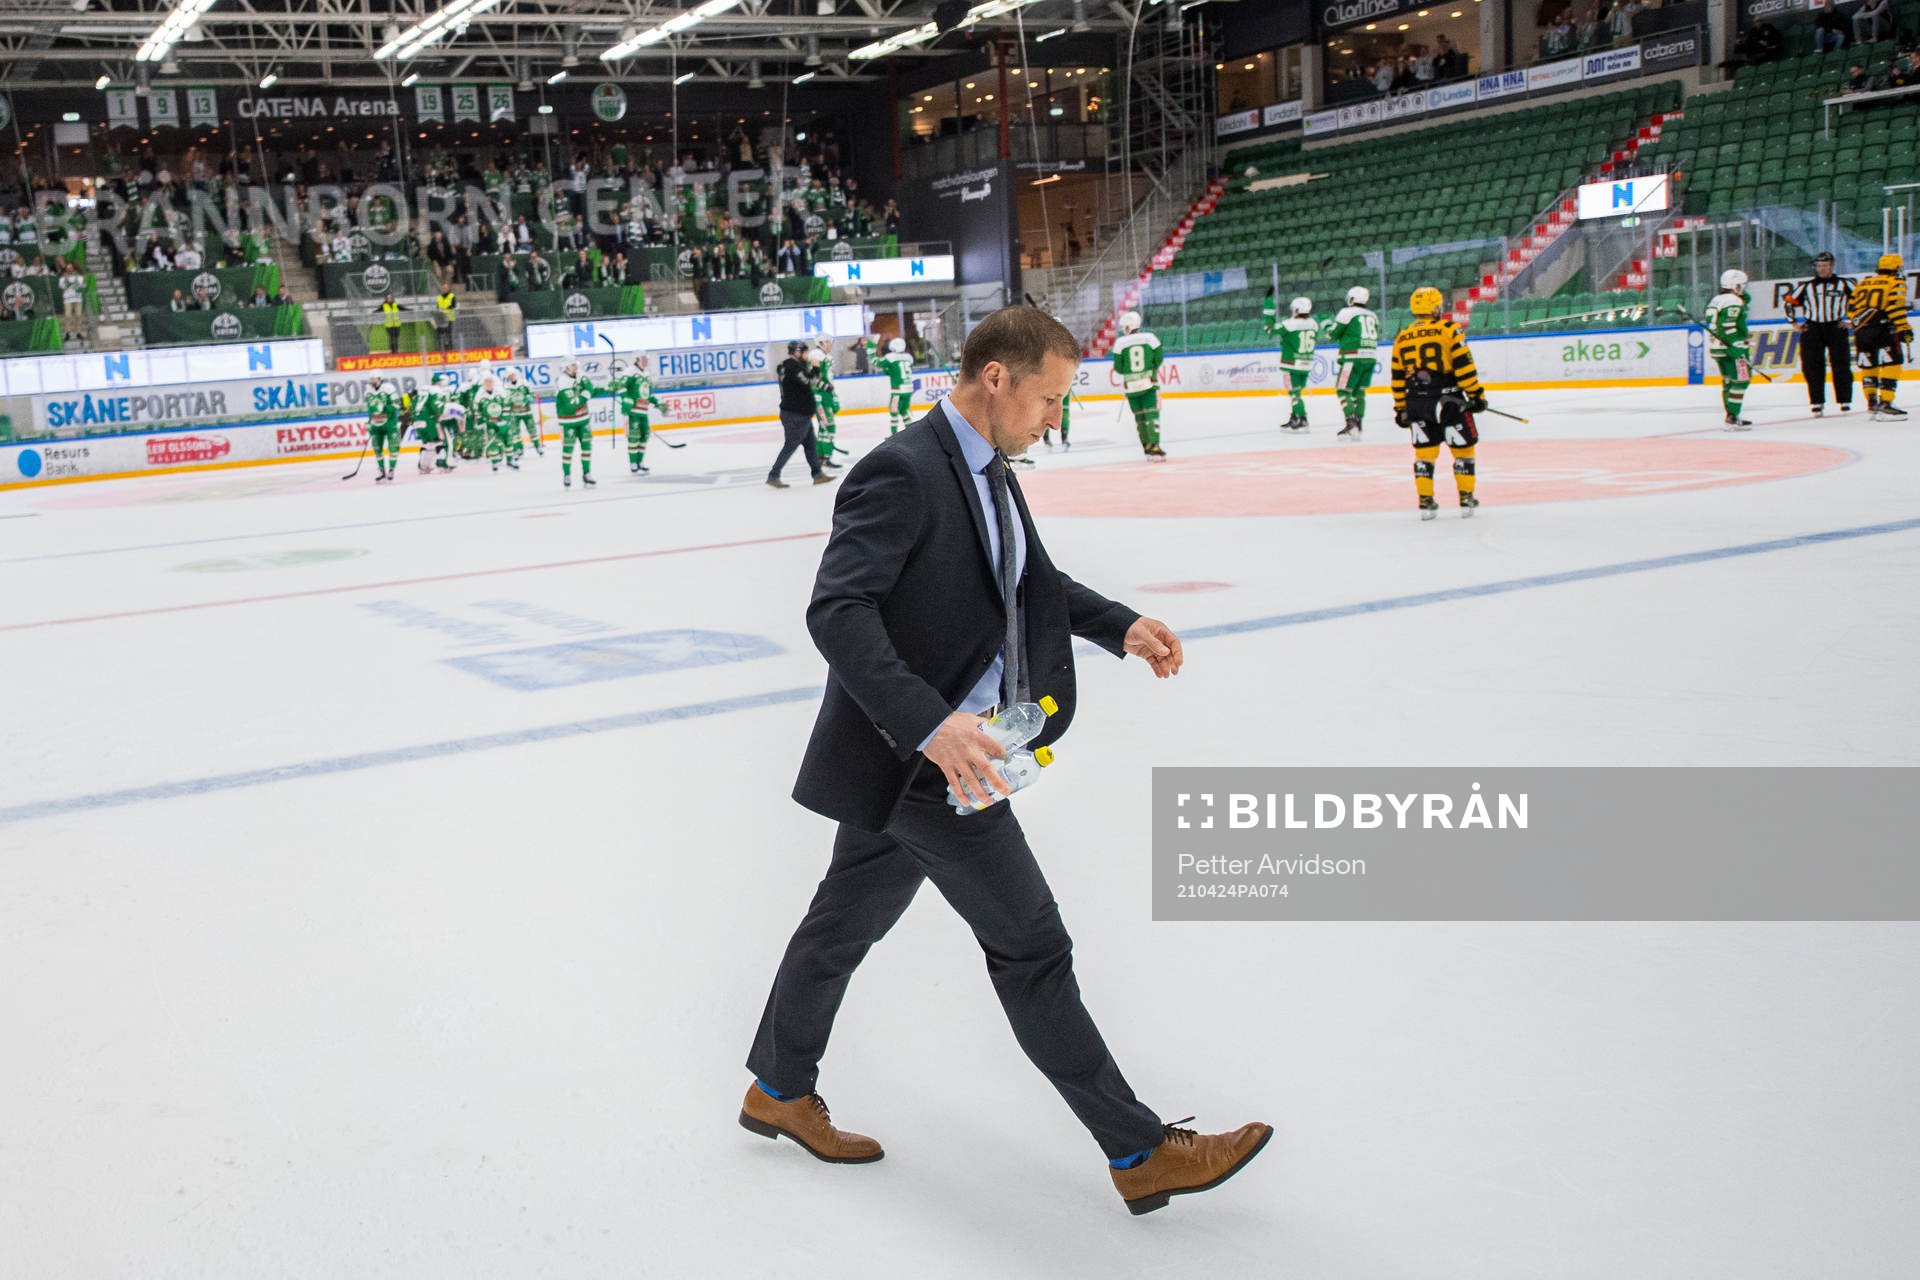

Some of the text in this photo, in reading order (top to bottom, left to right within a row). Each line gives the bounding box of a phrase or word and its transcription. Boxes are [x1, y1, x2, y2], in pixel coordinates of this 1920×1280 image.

[1479, 77, 1500, 91] HNA
[1503, 72, 1524, 86] HNA
[195, 98, 211, 114] 13
[238, 96, 400, 118] CATENA Arena
[422, 95, 436, 110] 19
[457, 95, 474, 110] 25
[1856, 288, 1884, 309] 20
[1298, 331, 1315, 353] 16
[1562, 339, 1621, 362] akea
[1129, 345, 1145, 372] 8
[1400, 342, 1444, 374] 58
[48, 391, 227, 427] SKÅNEPORTAR
[44, 446, 90, 460] Resurs
[46, 463, 80, 476] Bank
